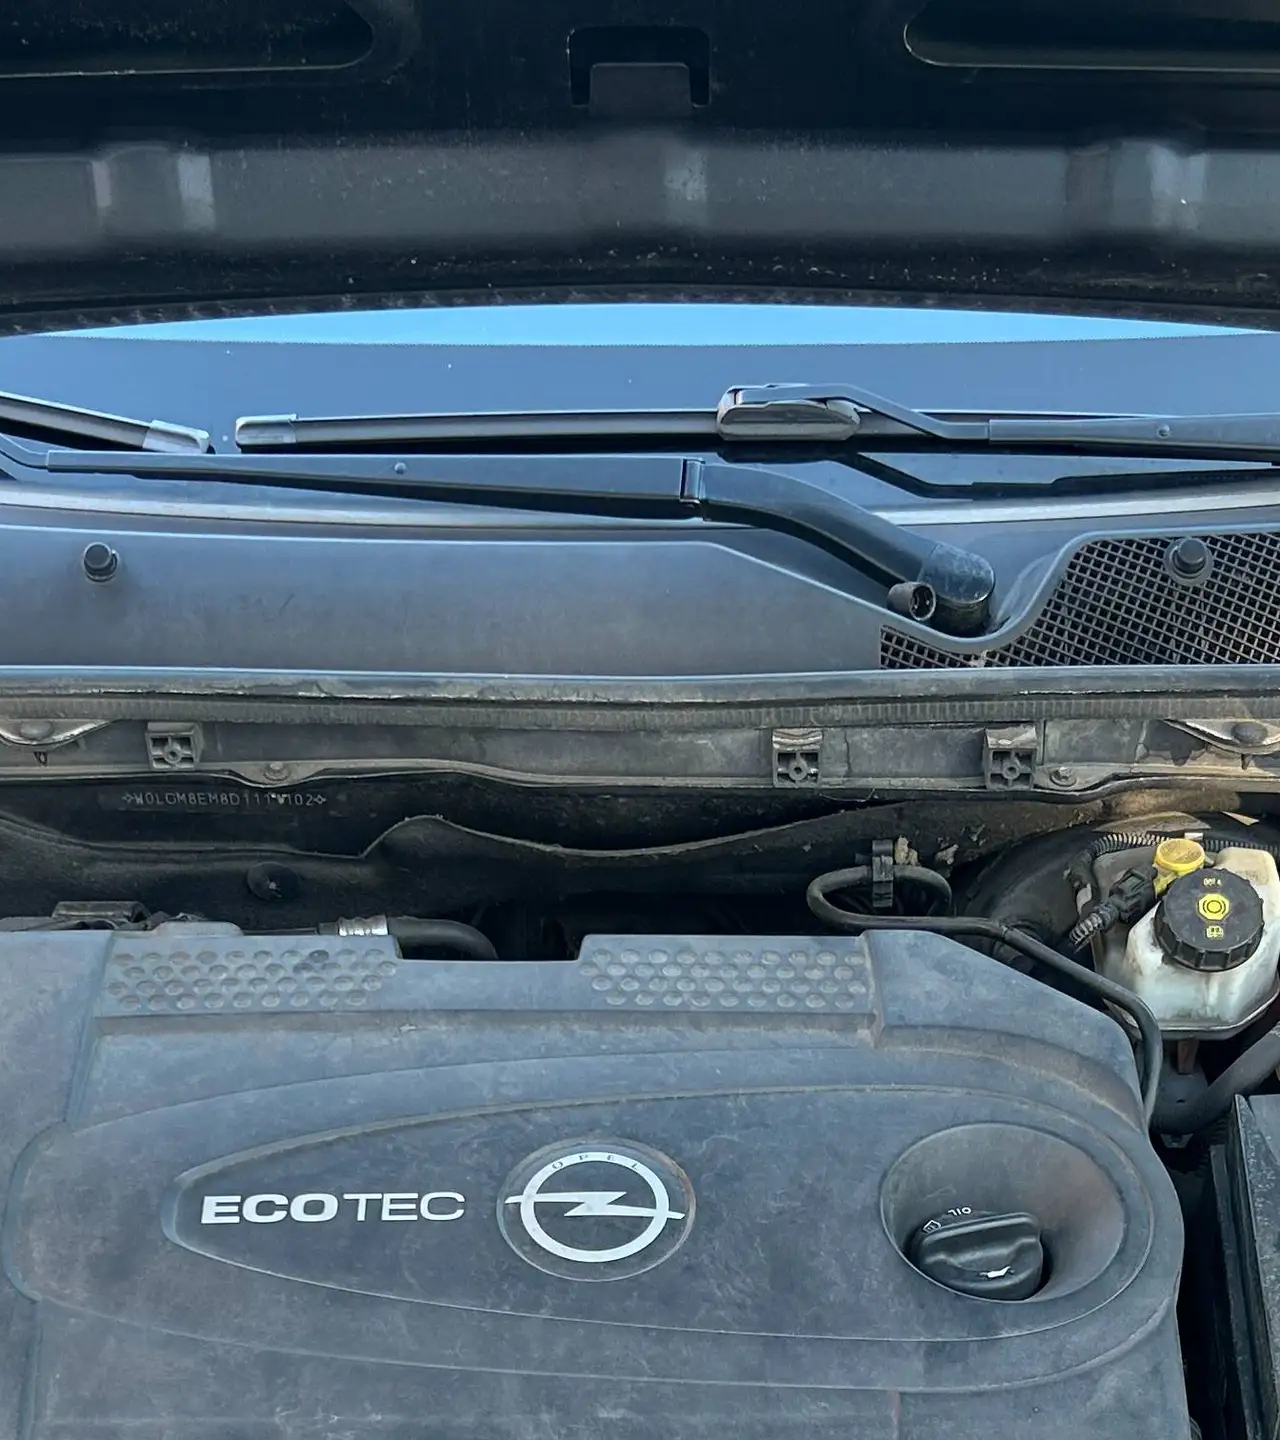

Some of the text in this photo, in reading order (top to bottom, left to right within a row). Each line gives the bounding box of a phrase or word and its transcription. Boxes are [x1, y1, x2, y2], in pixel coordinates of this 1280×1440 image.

[551, 1154, 639, 1170] OPEL
[200, 1191, 466, 1225] ECOTEC
[947, 1206, 972, 1216] OIL
